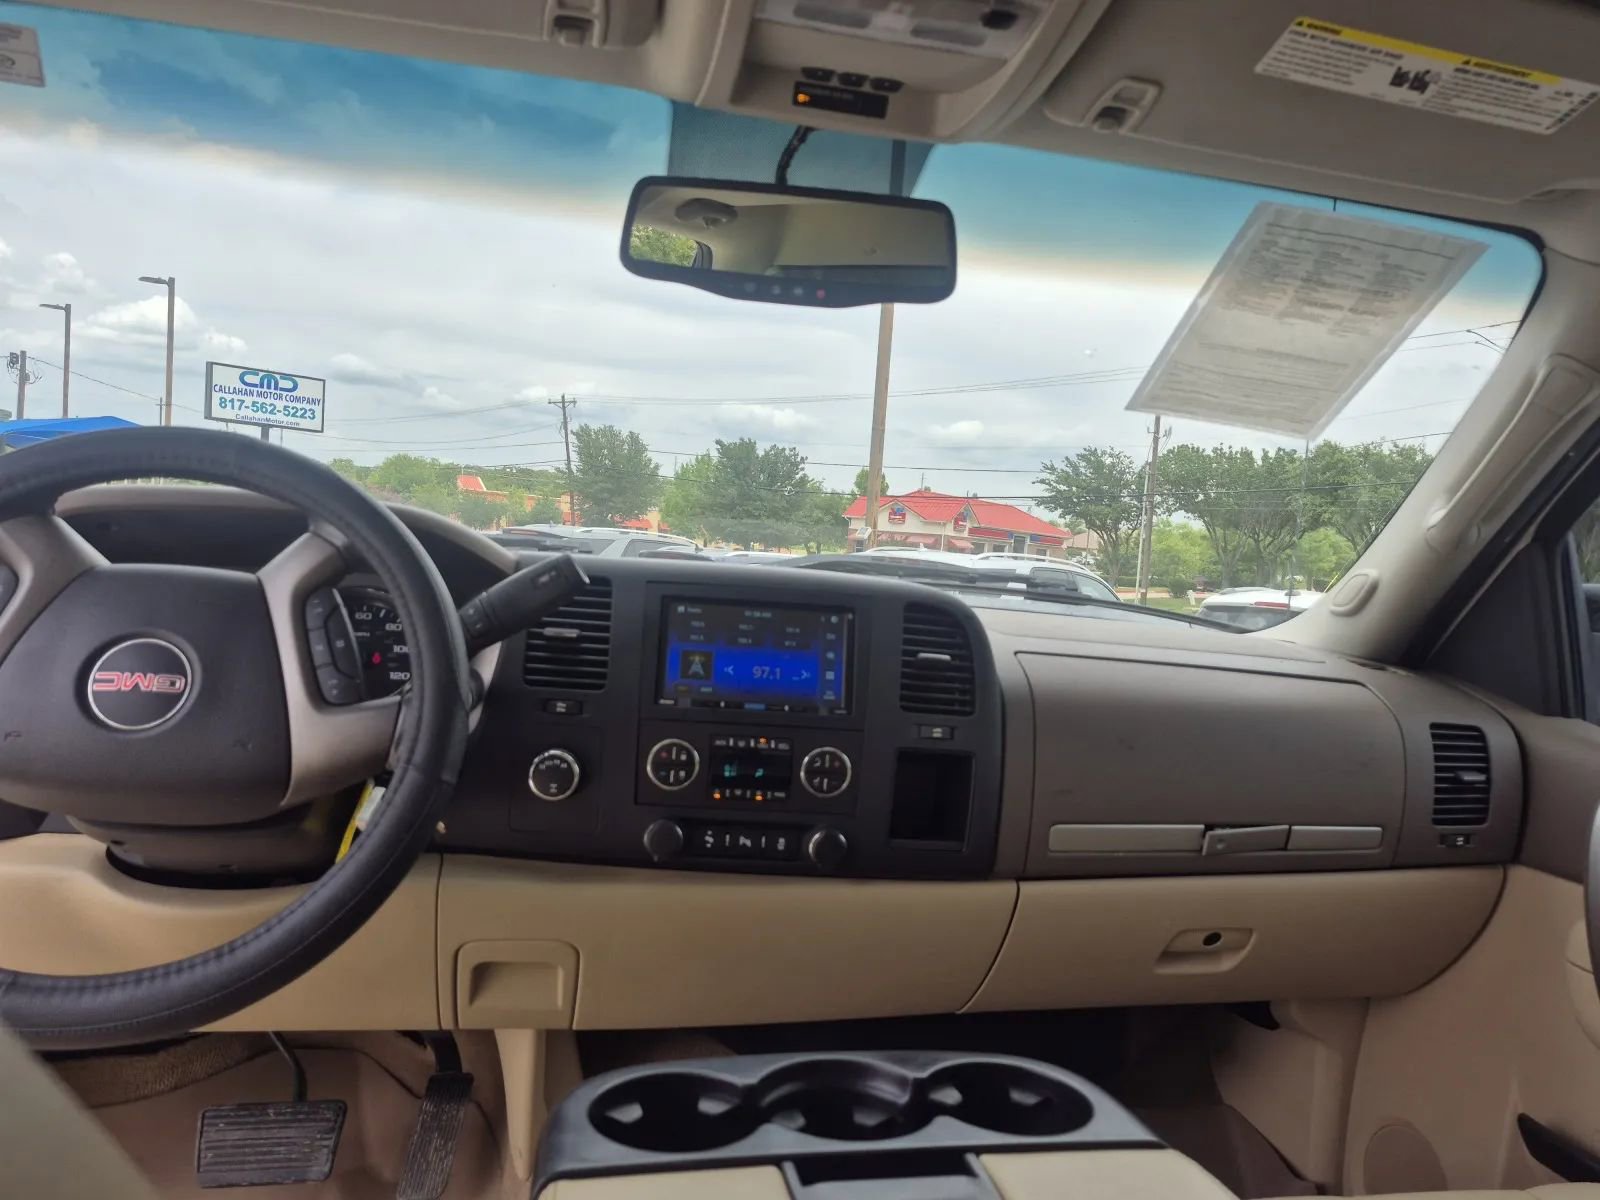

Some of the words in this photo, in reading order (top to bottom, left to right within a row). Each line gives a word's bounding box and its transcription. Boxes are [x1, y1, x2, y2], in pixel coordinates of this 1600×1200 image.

[239, 370, 298, 393] CMD
[213, 384, 255, 397] CALLAHAN
[256, 389, 283, 401] MOTOR
[284, 394, 321, 406] COMPANY
[219, 397, 316, 420] 817-562-5223
[355, 612, 372, 620] 60
[92, 671, 186, 693] GMC
[389, 672, 410, 680] 120
[752, 666, 781, 680] 97.1
